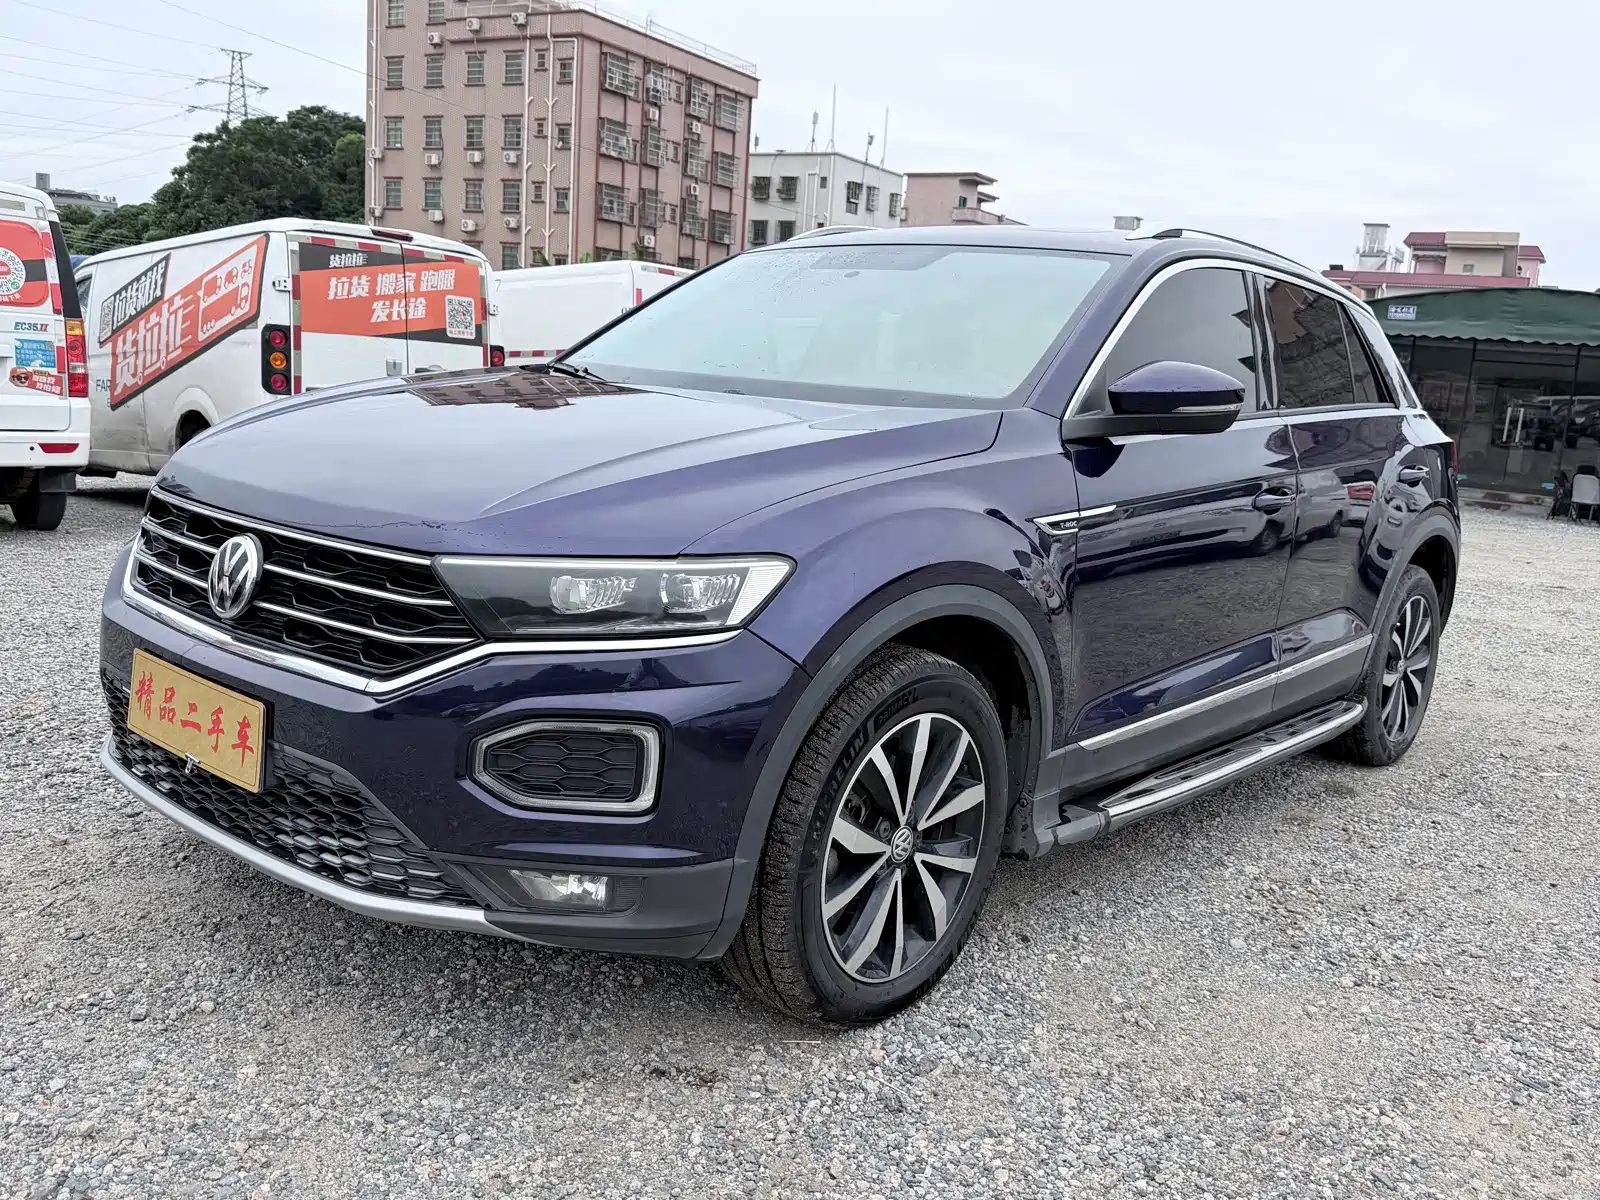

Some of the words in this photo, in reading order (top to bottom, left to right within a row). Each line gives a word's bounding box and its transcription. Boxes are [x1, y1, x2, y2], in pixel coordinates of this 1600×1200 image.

[329, 252, 364, 268] 货拉拉
[113, 260, 166, 330] 拉货就找
[328, 275, 371, 300] 拉货
[375, 271, 416, 296] 搬家
[420, 268, 455, 292] 跑腿
[370, 297, 426, 323] 发长途
[114, 295, 185, 396] 货拉拉
[1060, 520, 1078, 529] T-ROC
[135, 671, 254, 768] 精品二手车
